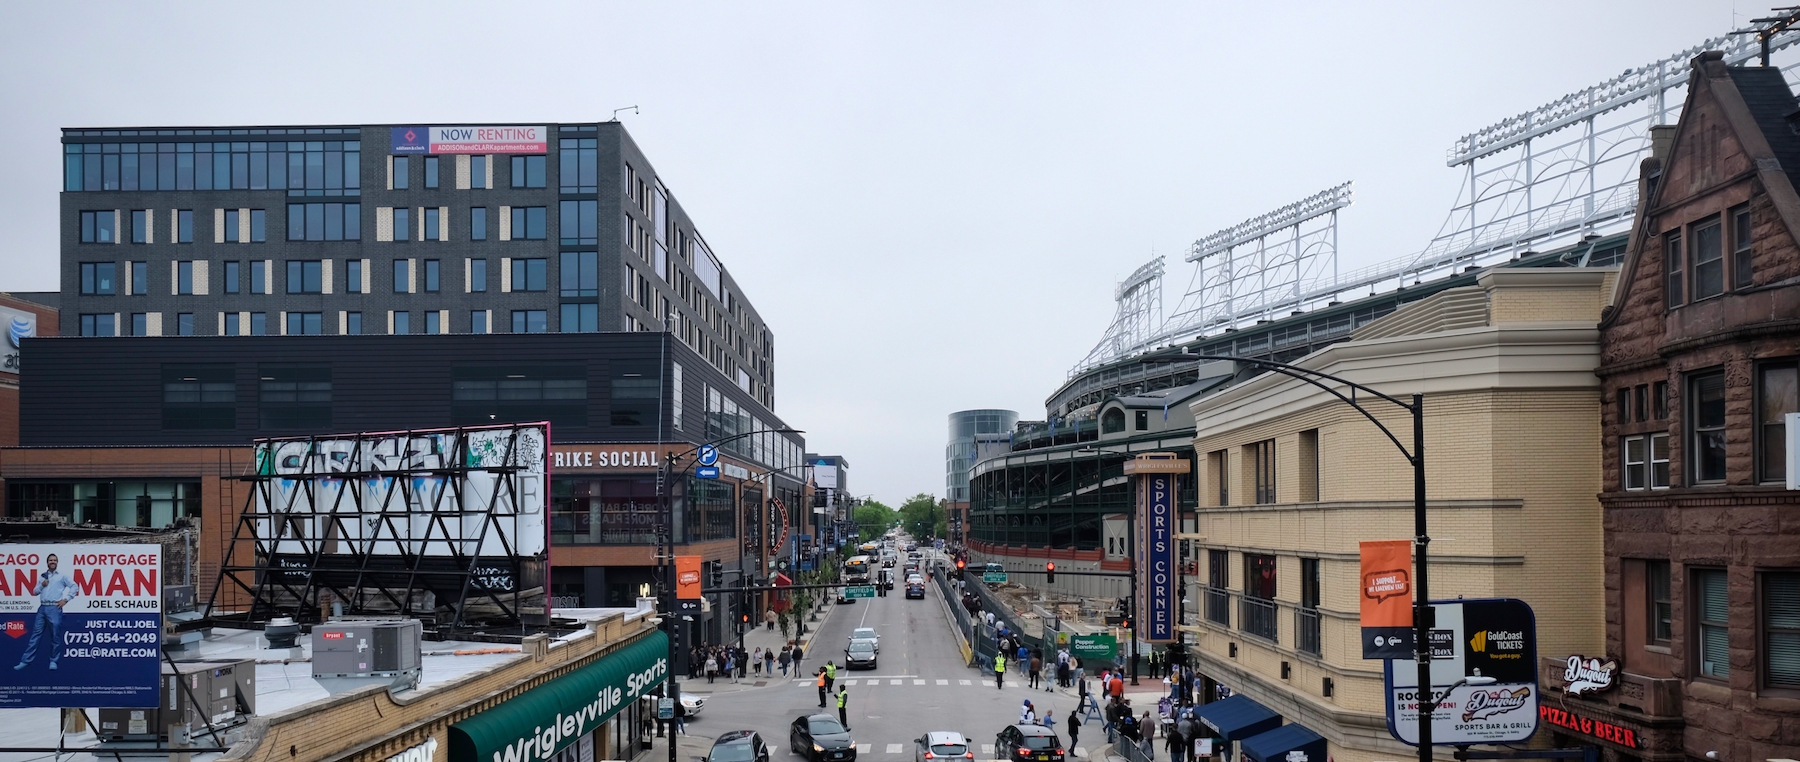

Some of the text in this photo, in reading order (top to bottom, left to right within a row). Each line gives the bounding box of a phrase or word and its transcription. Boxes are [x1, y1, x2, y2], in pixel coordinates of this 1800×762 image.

[441, 128, 536, 141] NOW RENTING
[550, 451, 658, 467] RIKE SOCIAL
[73, 554, 157, 566] MORTGAGE
[1154, 479, 1167, 634] SPORTS CORNER
[74, 568, 157, 596] MAN
[86, 600, 158, 609] JOEL SCHAUB
[7, 622, 24, 630] Rate
[85, 620, 157, 629] JUST CALL JOEL
[64, 631, 156, 646] (773) 654-2049
[1488, 631, 1523, 640] GoldCoast
[1496, 641, 1523, 650] TICKETS
[64, 648, 156, 659] JOEL@RATE.COM
[1564, 656, 1612, 684] Dugout
[1466, 690, 1524, 710] Dugout
[493, 685, 622, 762] Wrigleyville
[626, 658, 667, 698] Sports
[1539, 705, 1636, 748] PIZZA & BEER
